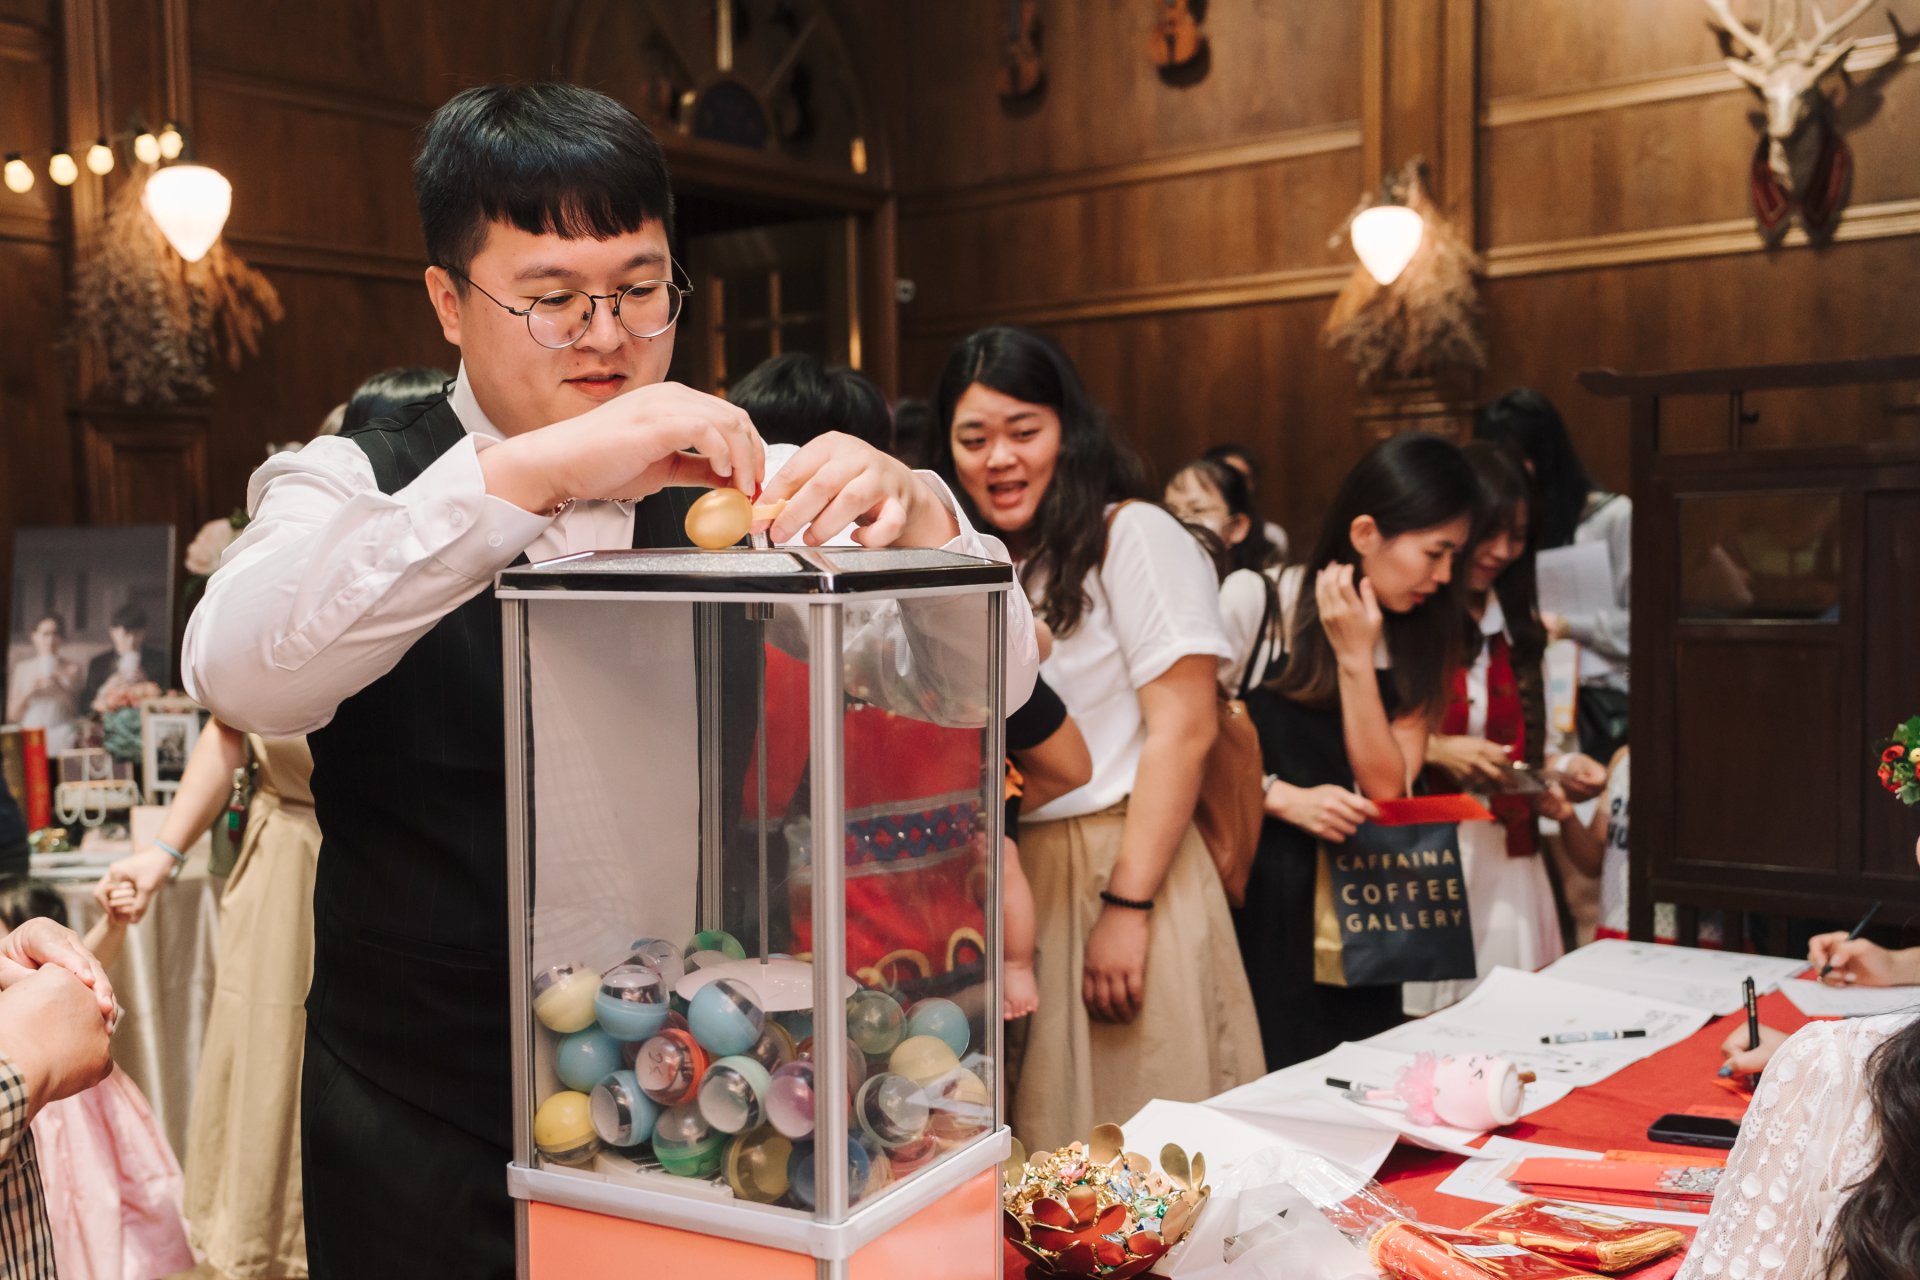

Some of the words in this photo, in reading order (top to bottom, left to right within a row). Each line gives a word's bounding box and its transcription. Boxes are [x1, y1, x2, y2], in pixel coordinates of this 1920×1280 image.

[1336, 849, 1455, 871] CAFFAINA
[1342, 878, 1460, 905] COFFEE
[1346, 909, 1462, 933] GALLERY
